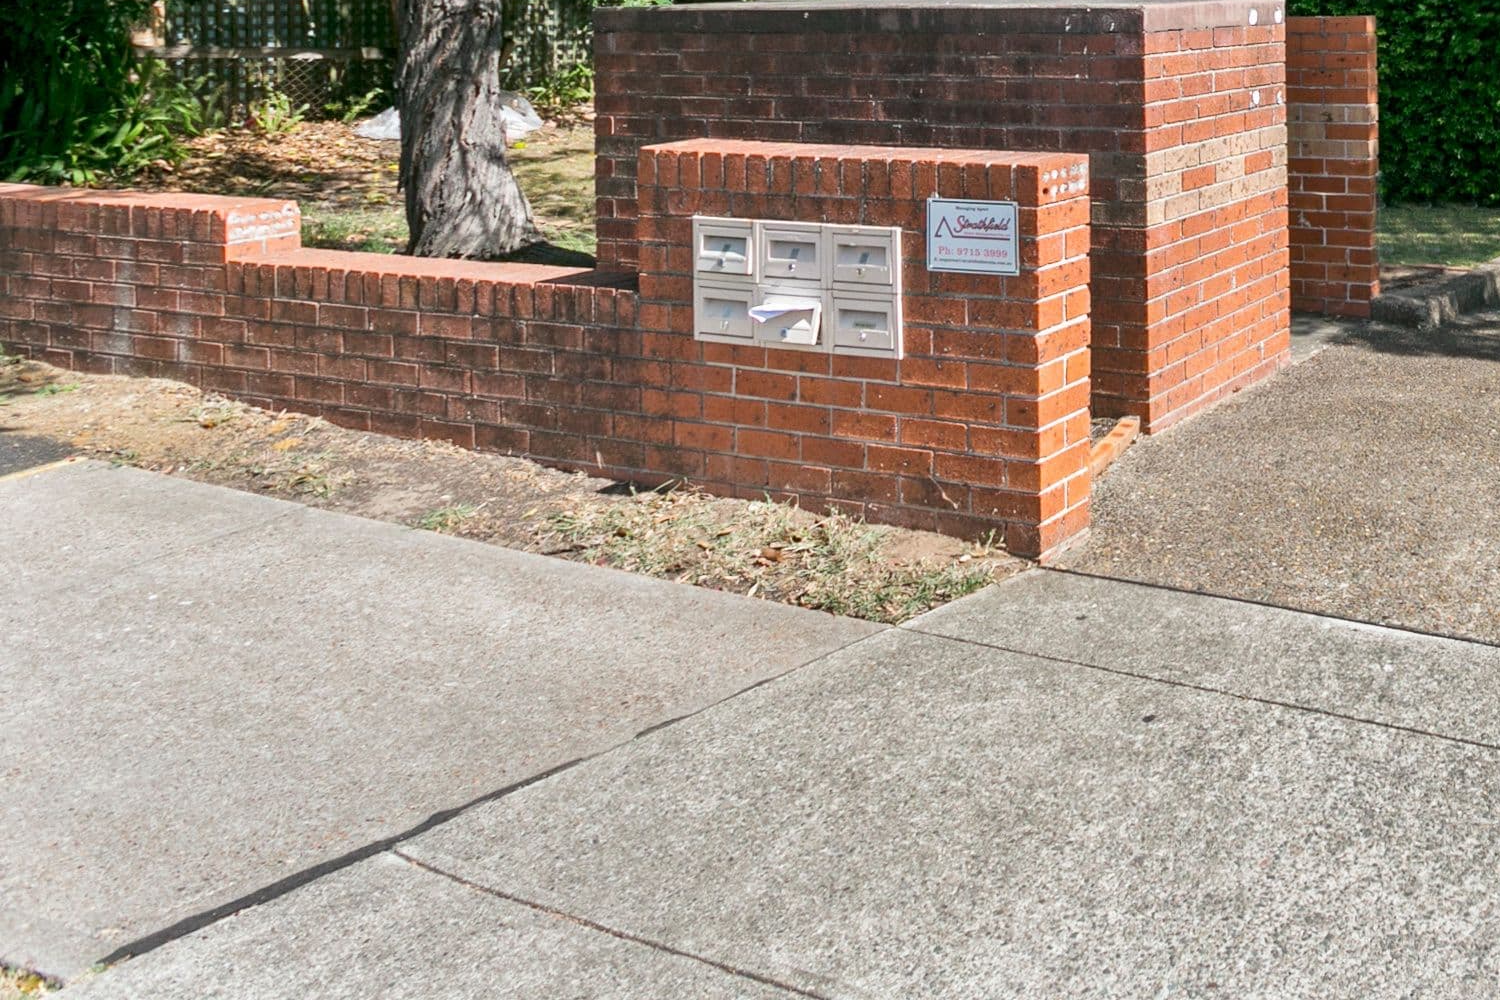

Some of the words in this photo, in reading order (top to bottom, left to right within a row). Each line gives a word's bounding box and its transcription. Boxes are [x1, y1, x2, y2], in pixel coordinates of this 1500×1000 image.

[953, 215, 1011, 233] Strathfield
[938, 246, 954, 256] Ph:
[956, 247, 981, 257] 9715
